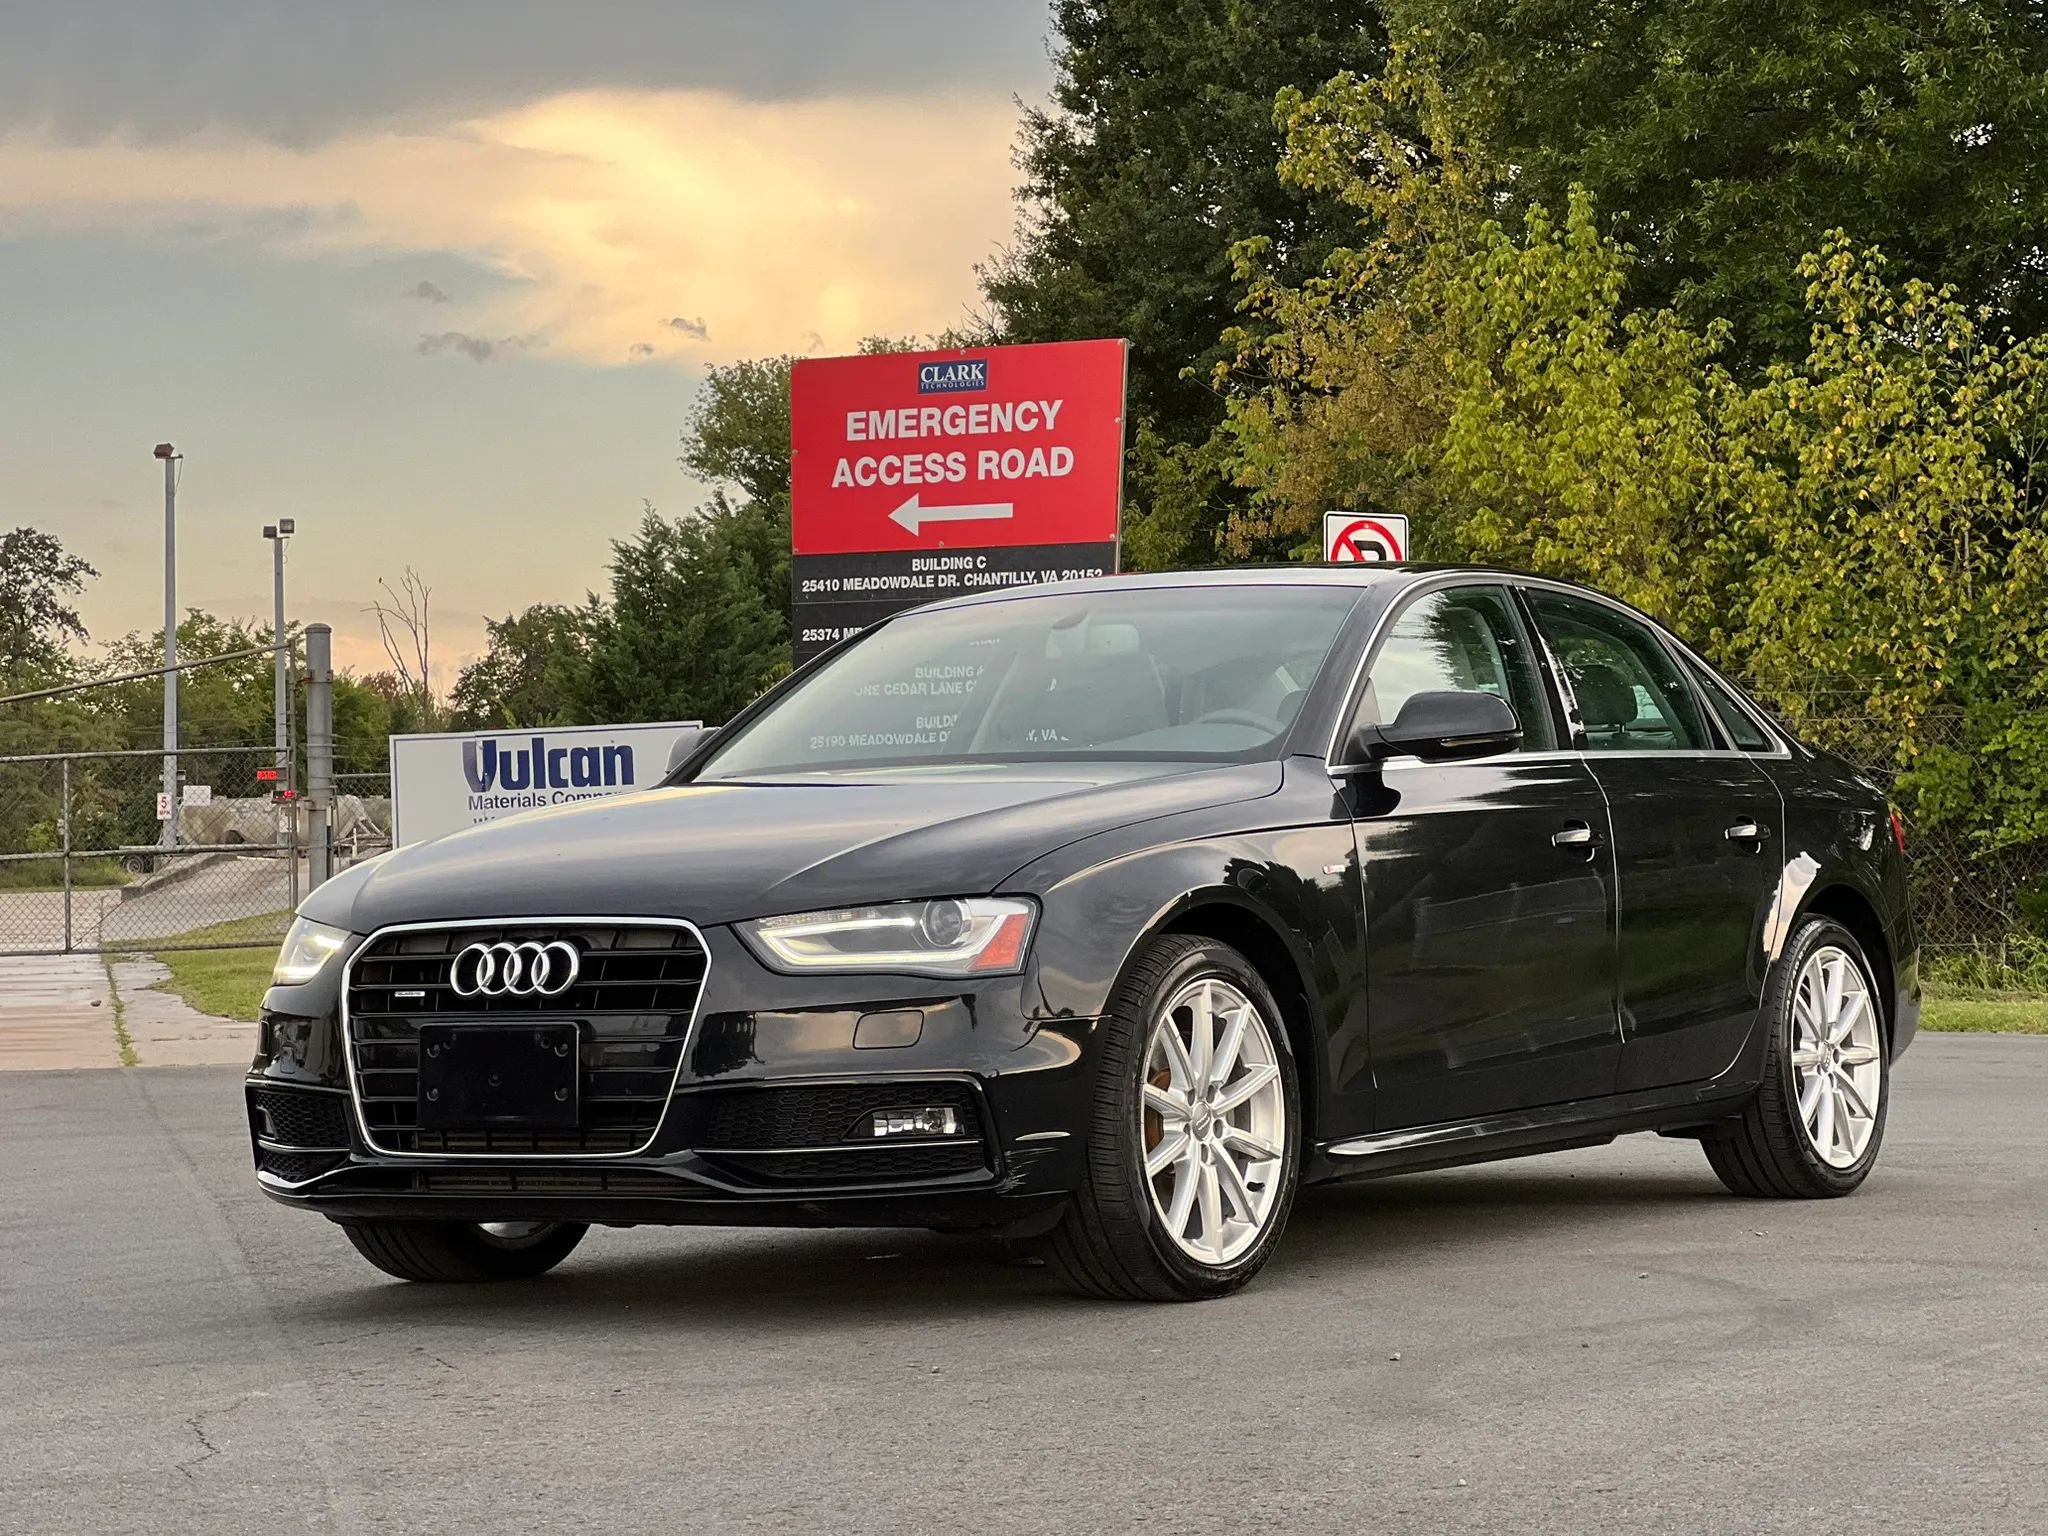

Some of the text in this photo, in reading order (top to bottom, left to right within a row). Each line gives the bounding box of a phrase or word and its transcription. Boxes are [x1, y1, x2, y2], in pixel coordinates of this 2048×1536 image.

[921, 363, 985, 382] CLARK
[921, 380, 985, 390] TECHNOLOGIES
[846, 400, 1064, 441] EMERGENCY
[831, 446, 1075, 488] ACCESS ROAD
[912, 556, 987, 571] BUILDING C
[802, 579, 840, 592] 25410
[843, 575, 935, 591] MEADOWDALE
[938, 574, 960, 587] DR.
[964, 571, 1038, 586] CHANTILLY,
[1041, 570, 1058, 583] VA
[802, 628, 840, 642] 25374
[915, 665, 975, 679] BUILDING
[884, 682, 927, 696] CEDAR
[931, 680, 963, 695] LANE
[966, 680, 977, 693] C
[916, 714, 958, 729] BUILD
[810, 735, 846, 750] 25190
[848, 732, 937, 746] MEADOWDALE
[1041, 729, 1058, 741] VA
[461, 737, 635, 793] Vulcan
[161, 796, 167, 809] 5
[468, 792, 547, 811] Materials
